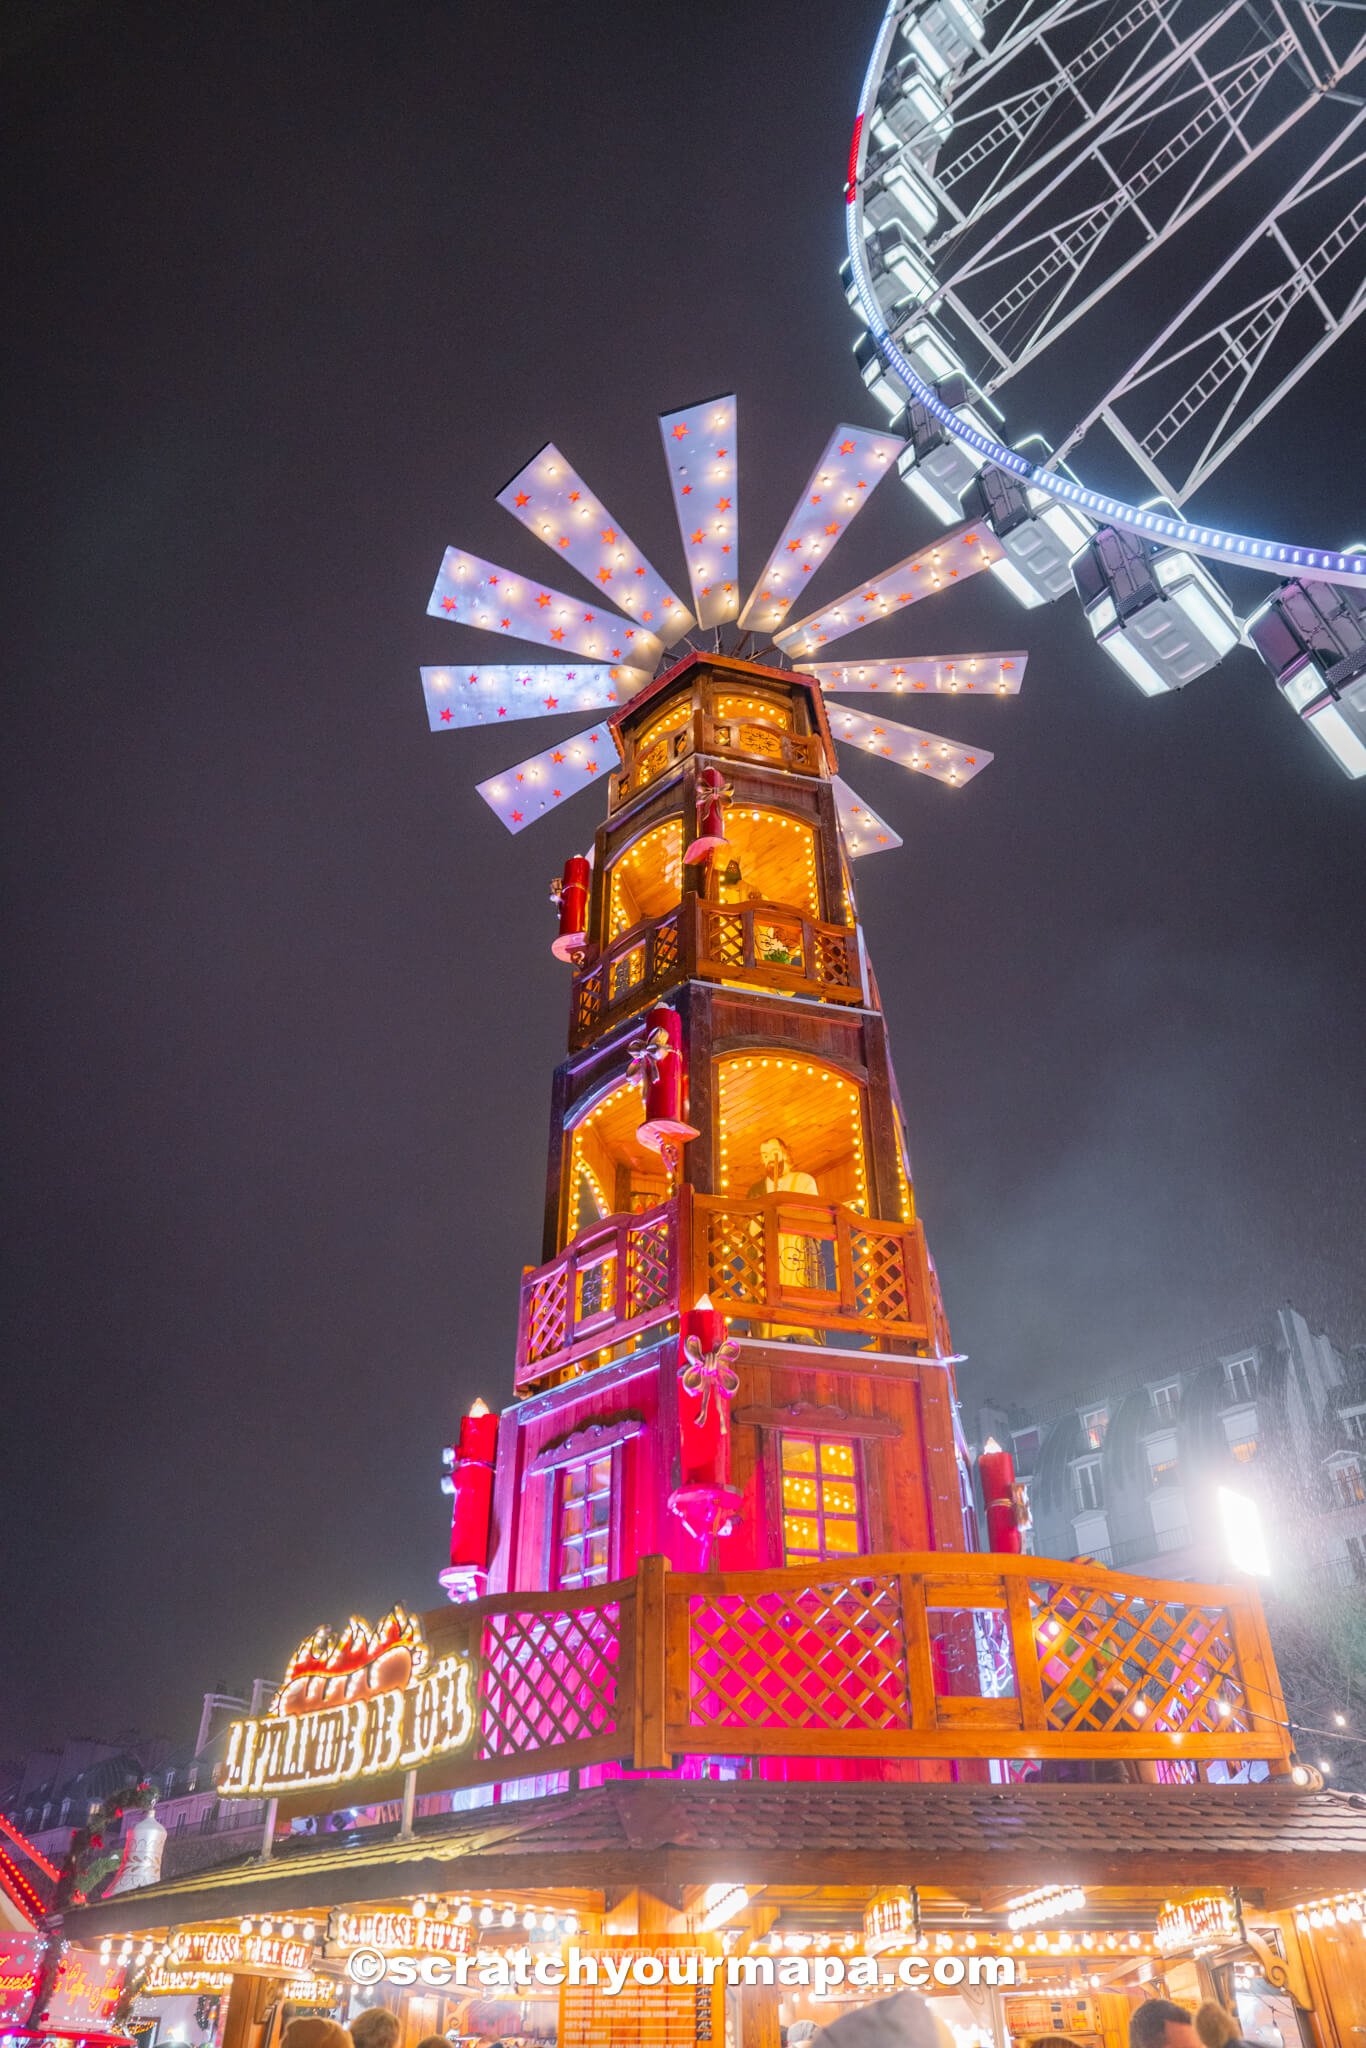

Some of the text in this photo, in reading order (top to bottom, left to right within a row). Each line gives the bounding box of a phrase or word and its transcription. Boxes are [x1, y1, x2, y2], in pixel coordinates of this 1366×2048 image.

[400, 1656, 476, 1766] NOËL
[172, 1932, 246, 1964] SAUCISSE
[338, 1914, 418, 1948] SAUCISSE
